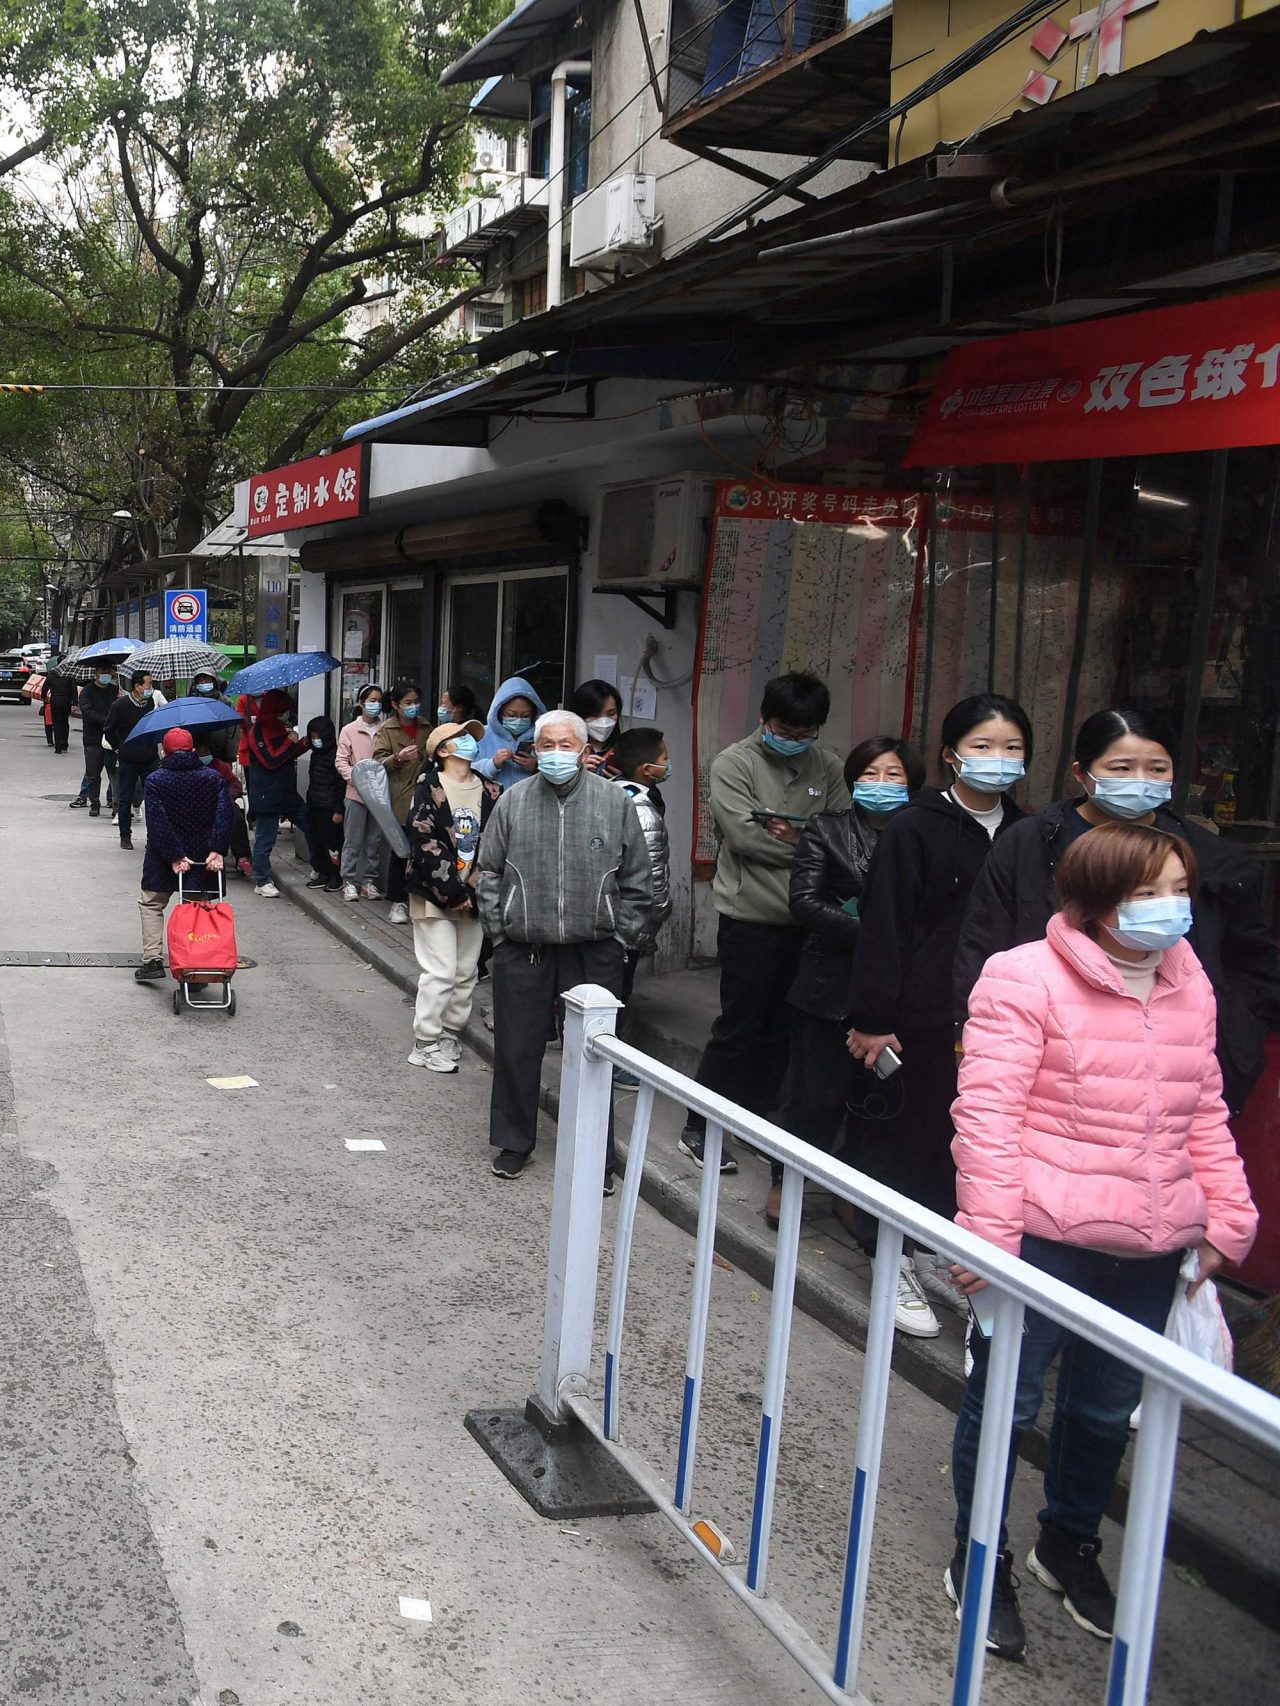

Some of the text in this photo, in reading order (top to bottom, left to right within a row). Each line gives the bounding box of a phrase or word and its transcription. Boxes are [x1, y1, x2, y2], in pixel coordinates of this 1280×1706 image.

[1014, 400, 1049, 413] LOTTERY
[274, 466, 357, 519] 定制水饺
[266, 580, 282, 593] 110
[169, 624, 202, 633] 消防通道
